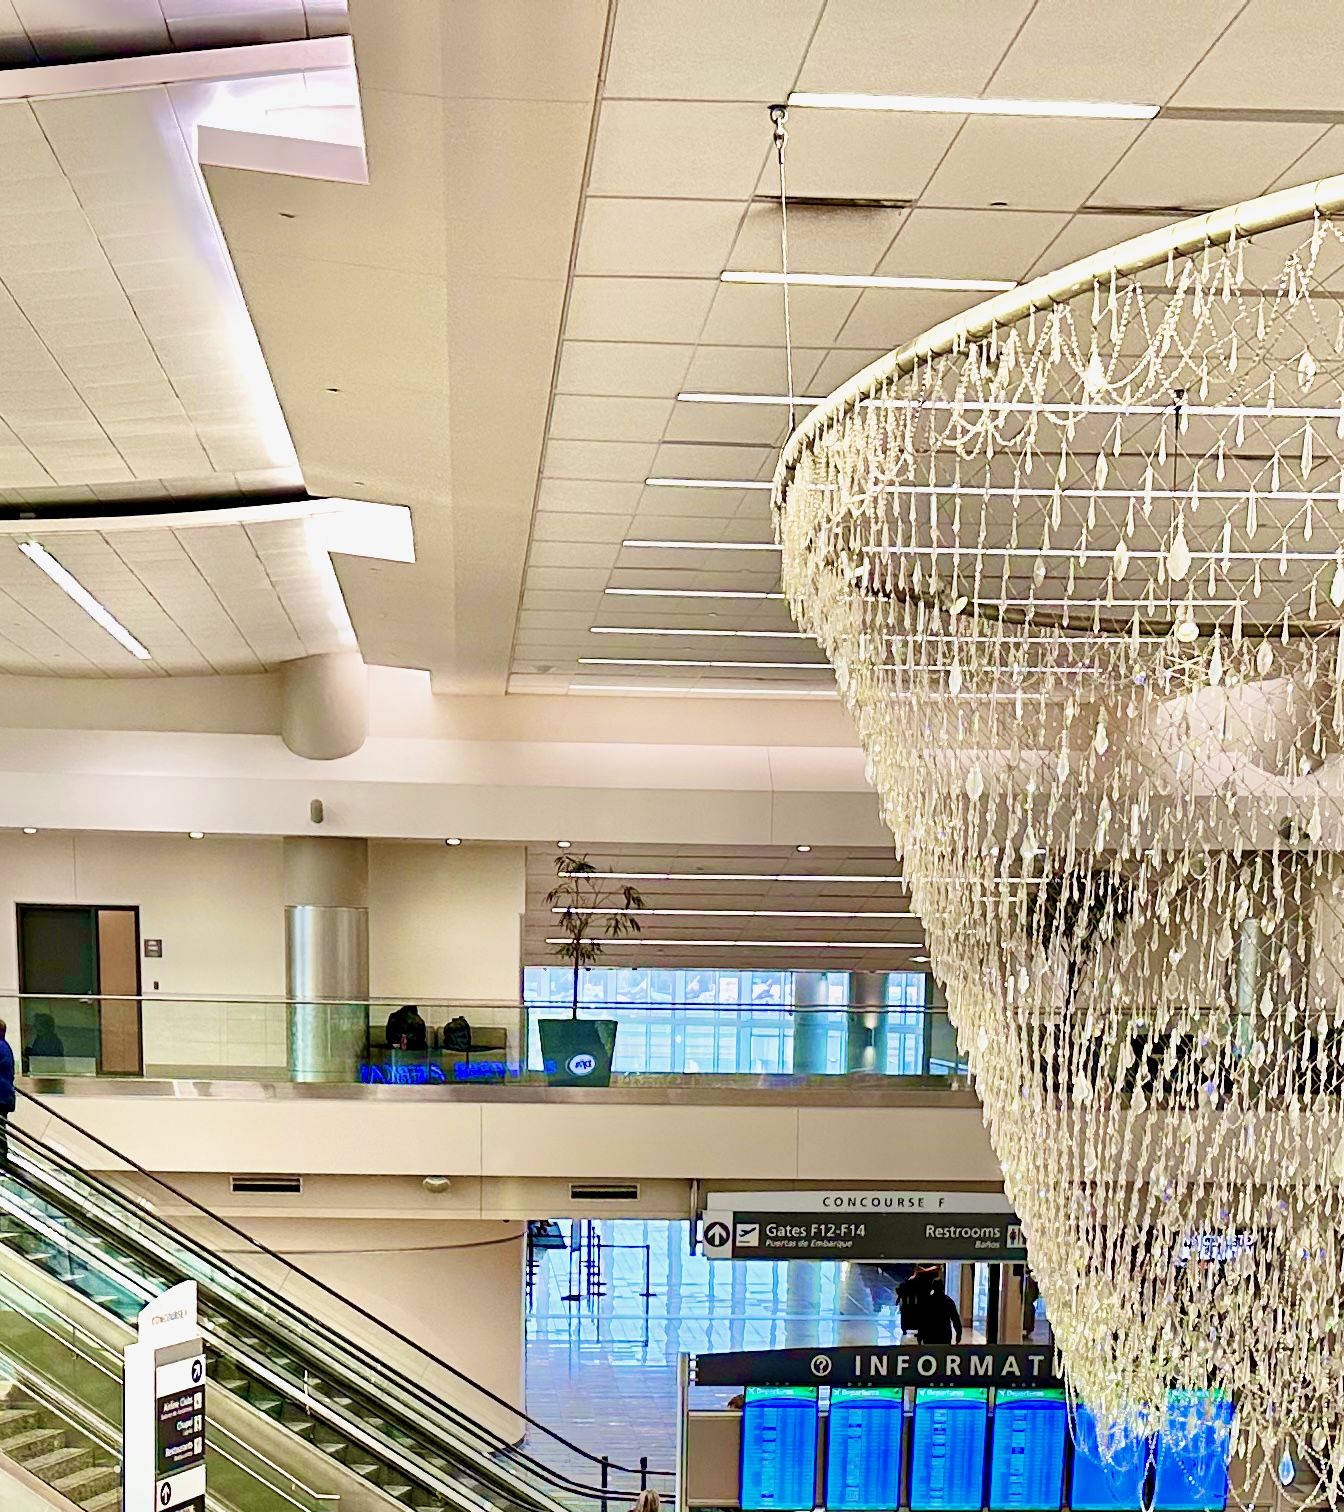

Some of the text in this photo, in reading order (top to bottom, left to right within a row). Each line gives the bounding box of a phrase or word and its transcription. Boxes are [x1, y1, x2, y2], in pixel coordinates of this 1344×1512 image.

[822, 1196, 946, 1209] CONCOURSE F
[765, 1223, 866, 1238] Gates F12-F14
[925, 1224, 1001, 1238] Restrooms
[765, 1238, 853, 1249] Puertas de Embarque
[974, 1239, 1000, 1249] Baños
[855, 1354, 1058, 1378] INFORMATI
